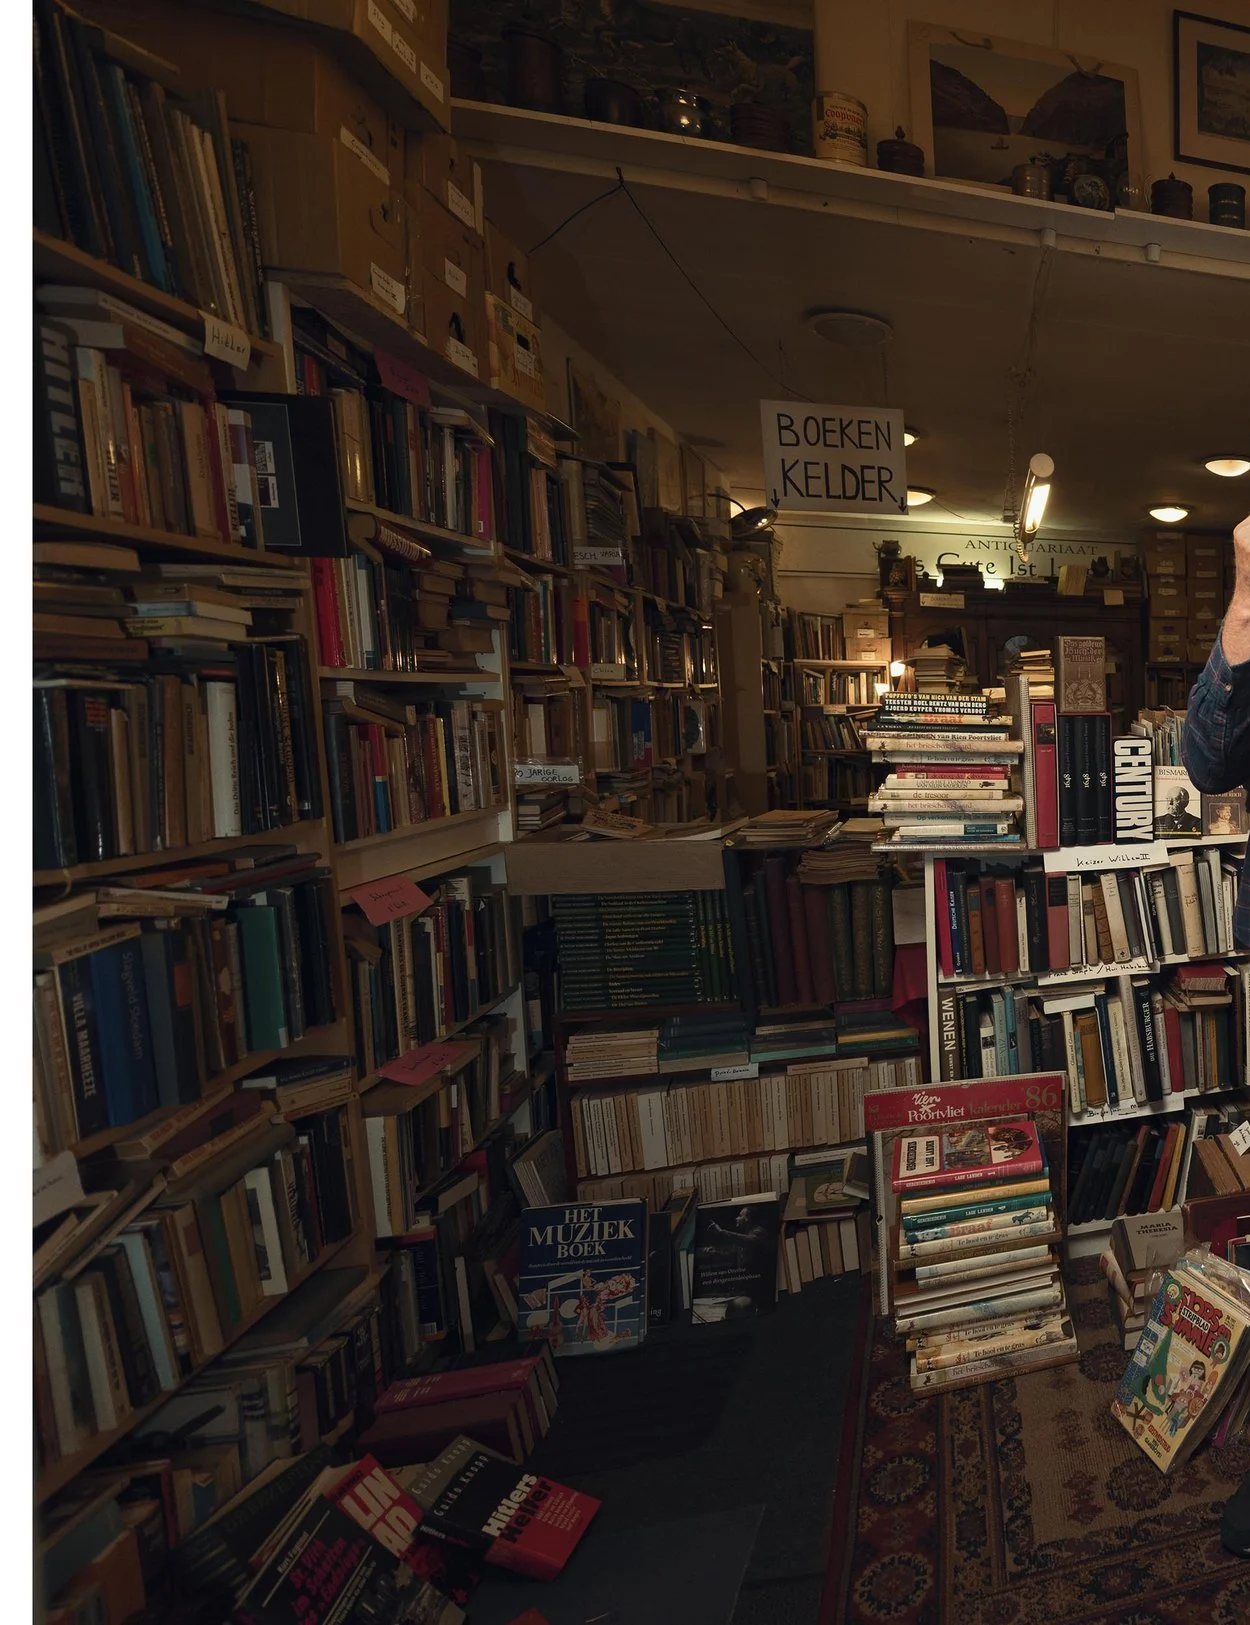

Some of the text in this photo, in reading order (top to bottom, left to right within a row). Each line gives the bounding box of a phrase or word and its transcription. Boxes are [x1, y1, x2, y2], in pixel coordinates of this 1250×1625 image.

[40, 325, 85, 496] HITLER
[776, 413, 892, 452] BOEKEN
[781, 458, 898, 504] KELDER
[885, 699, 911, 707] TEKSTEN
[885, 705, 909, 713] SJOERD
[934, 706, 959, 714] THOMAS
[918, 692, 930, 700] VAN
[930, 693, 946, 701] NICO
[946, 694, 957, 702] VAN
[1113, 740, 1155, 841] CENTURY
[71, 991, 86, 1029] VILLA
[941, 997, 958, 1051] WENEN
[907, 1097, 1023, 1123] Poortvliet kalender
[563, 1207, 604, 1224] HET
[1140, 1222, 1173, 1230] MARIA
[527, 1218, 636, 1248] MUZIEK
[1136, 1226, 1179, 1236] THERESIA
[556, 1241, 607, 1259] BOEK
[1181, 1307, 1211, 1333] STRIPBLAD
[433, 1455, 490, 1518] Guido Knopp
[481, 1472, 539, 1539] Hitlers
[501, 1480, 554, 1545] Helfer
